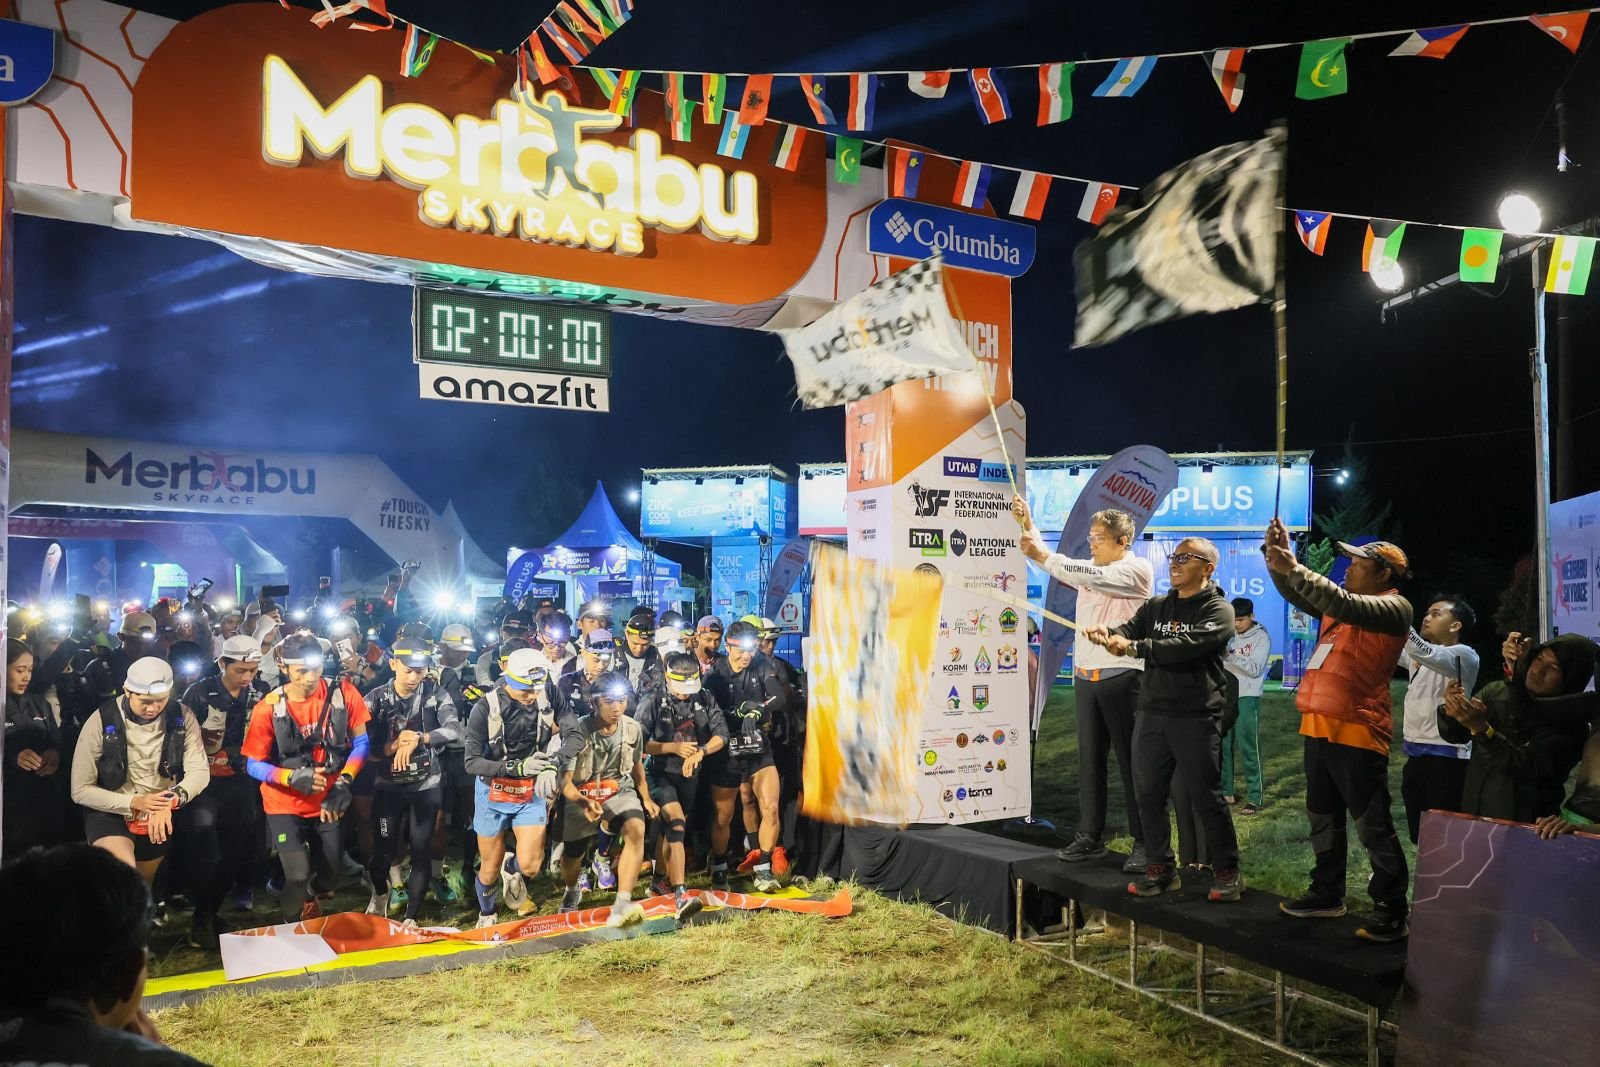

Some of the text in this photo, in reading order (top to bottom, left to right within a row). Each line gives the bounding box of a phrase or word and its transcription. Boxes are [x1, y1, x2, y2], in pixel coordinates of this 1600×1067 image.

[262, 54, 759, 242] Merbabu
[421, 189, 644, 253] SKYRACE
[913, 218, 1020, 265] Columbia
[432, 304, 601, 366] 02:00:00
[433, 376, 597, 409] amazfit
[86, 447, 315, 495] Merbabu
[948, 461, 976, 473] UTMB
[954, 490, 1005, 501] INTERNATIONAL
[1102, 472, 1157, 511] AQUVIVA
[154, 492, 255, 505] SKYRACE
[381, 498, 429, 516] #TOUCH
[954, 509, 998, 519] FEDERATION
[379, 513, 430, 532] THESKY
[969, 538, 1016, 548] NATIONAL
[969, 548, 1006, 557] LEAGUE
[717, 555, 743, 568] ZINC
[719, 568, 741, 576] COOL
[943, 664, 968, 672] KORMI
[520, 921, 566, 933] SKYRUNNING
